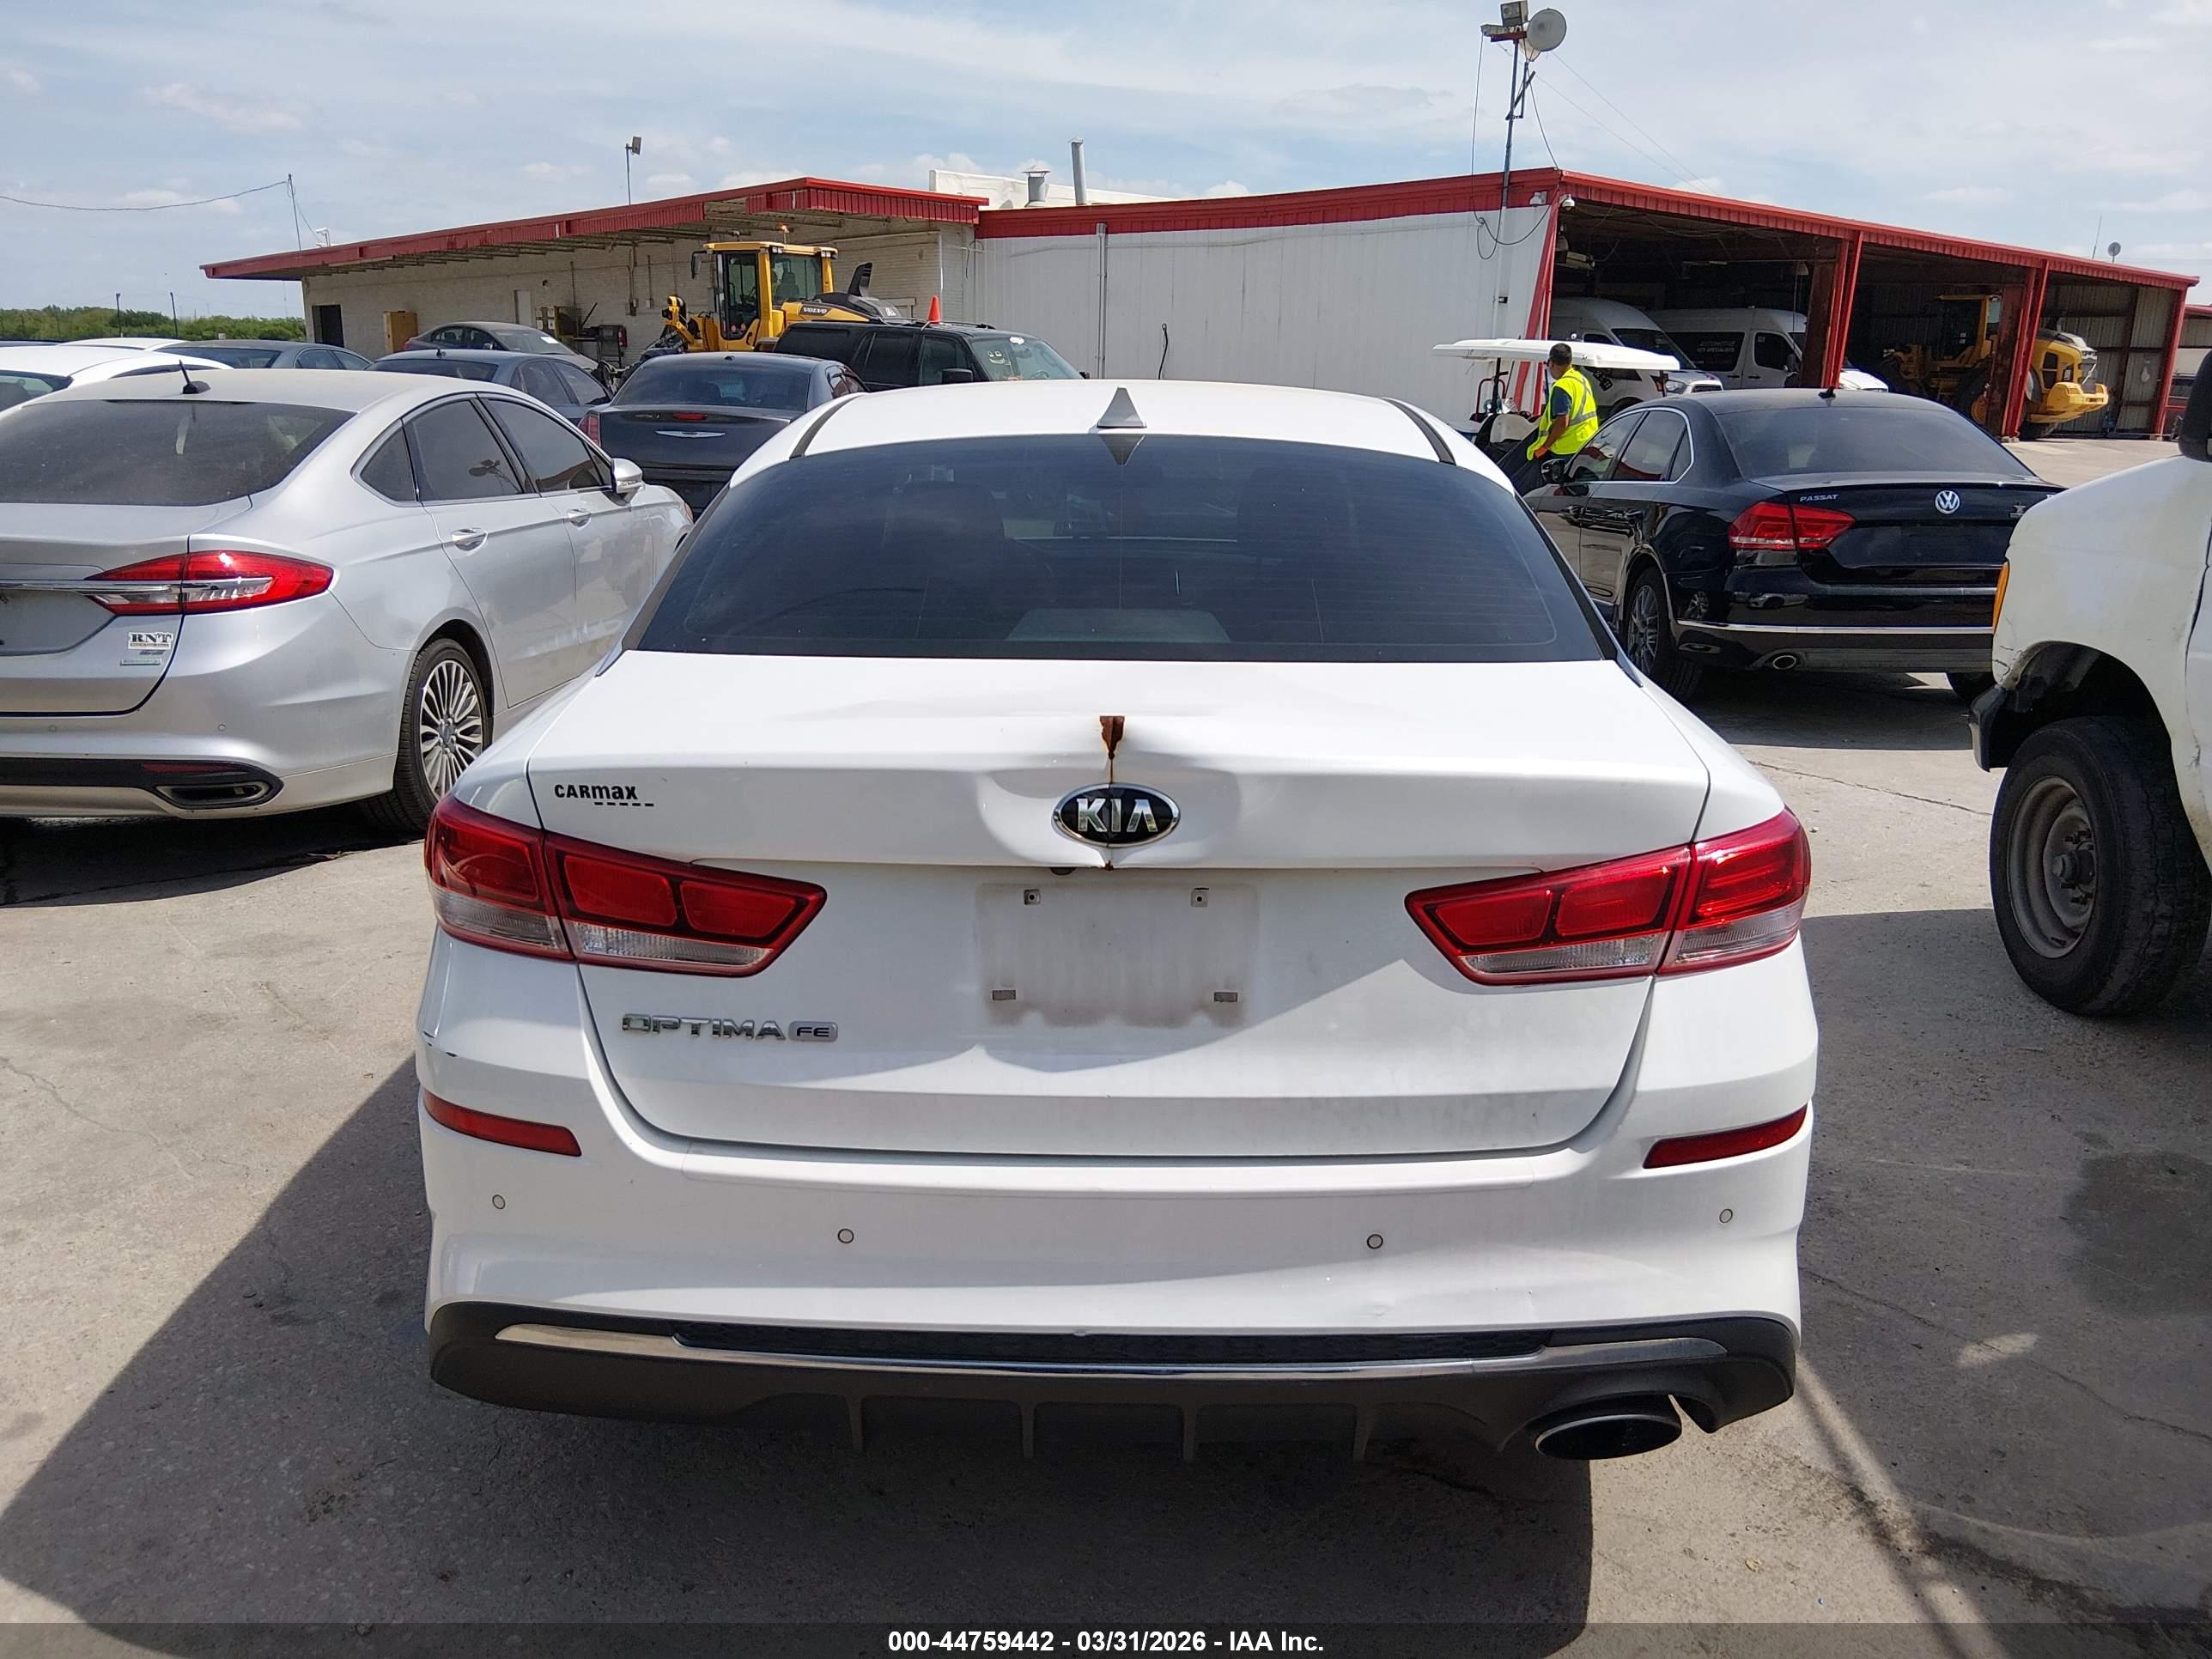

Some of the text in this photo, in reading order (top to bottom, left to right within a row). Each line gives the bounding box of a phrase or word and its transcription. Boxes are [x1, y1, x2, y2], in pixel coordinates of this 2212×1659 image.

[1799, 494, 1839, 502] PASSAT
[130, 632, 172, 643] RNT
[1077, 798, 1158, 832] KIA
[622, 1013, 830, 1040] OPTIMA FE
